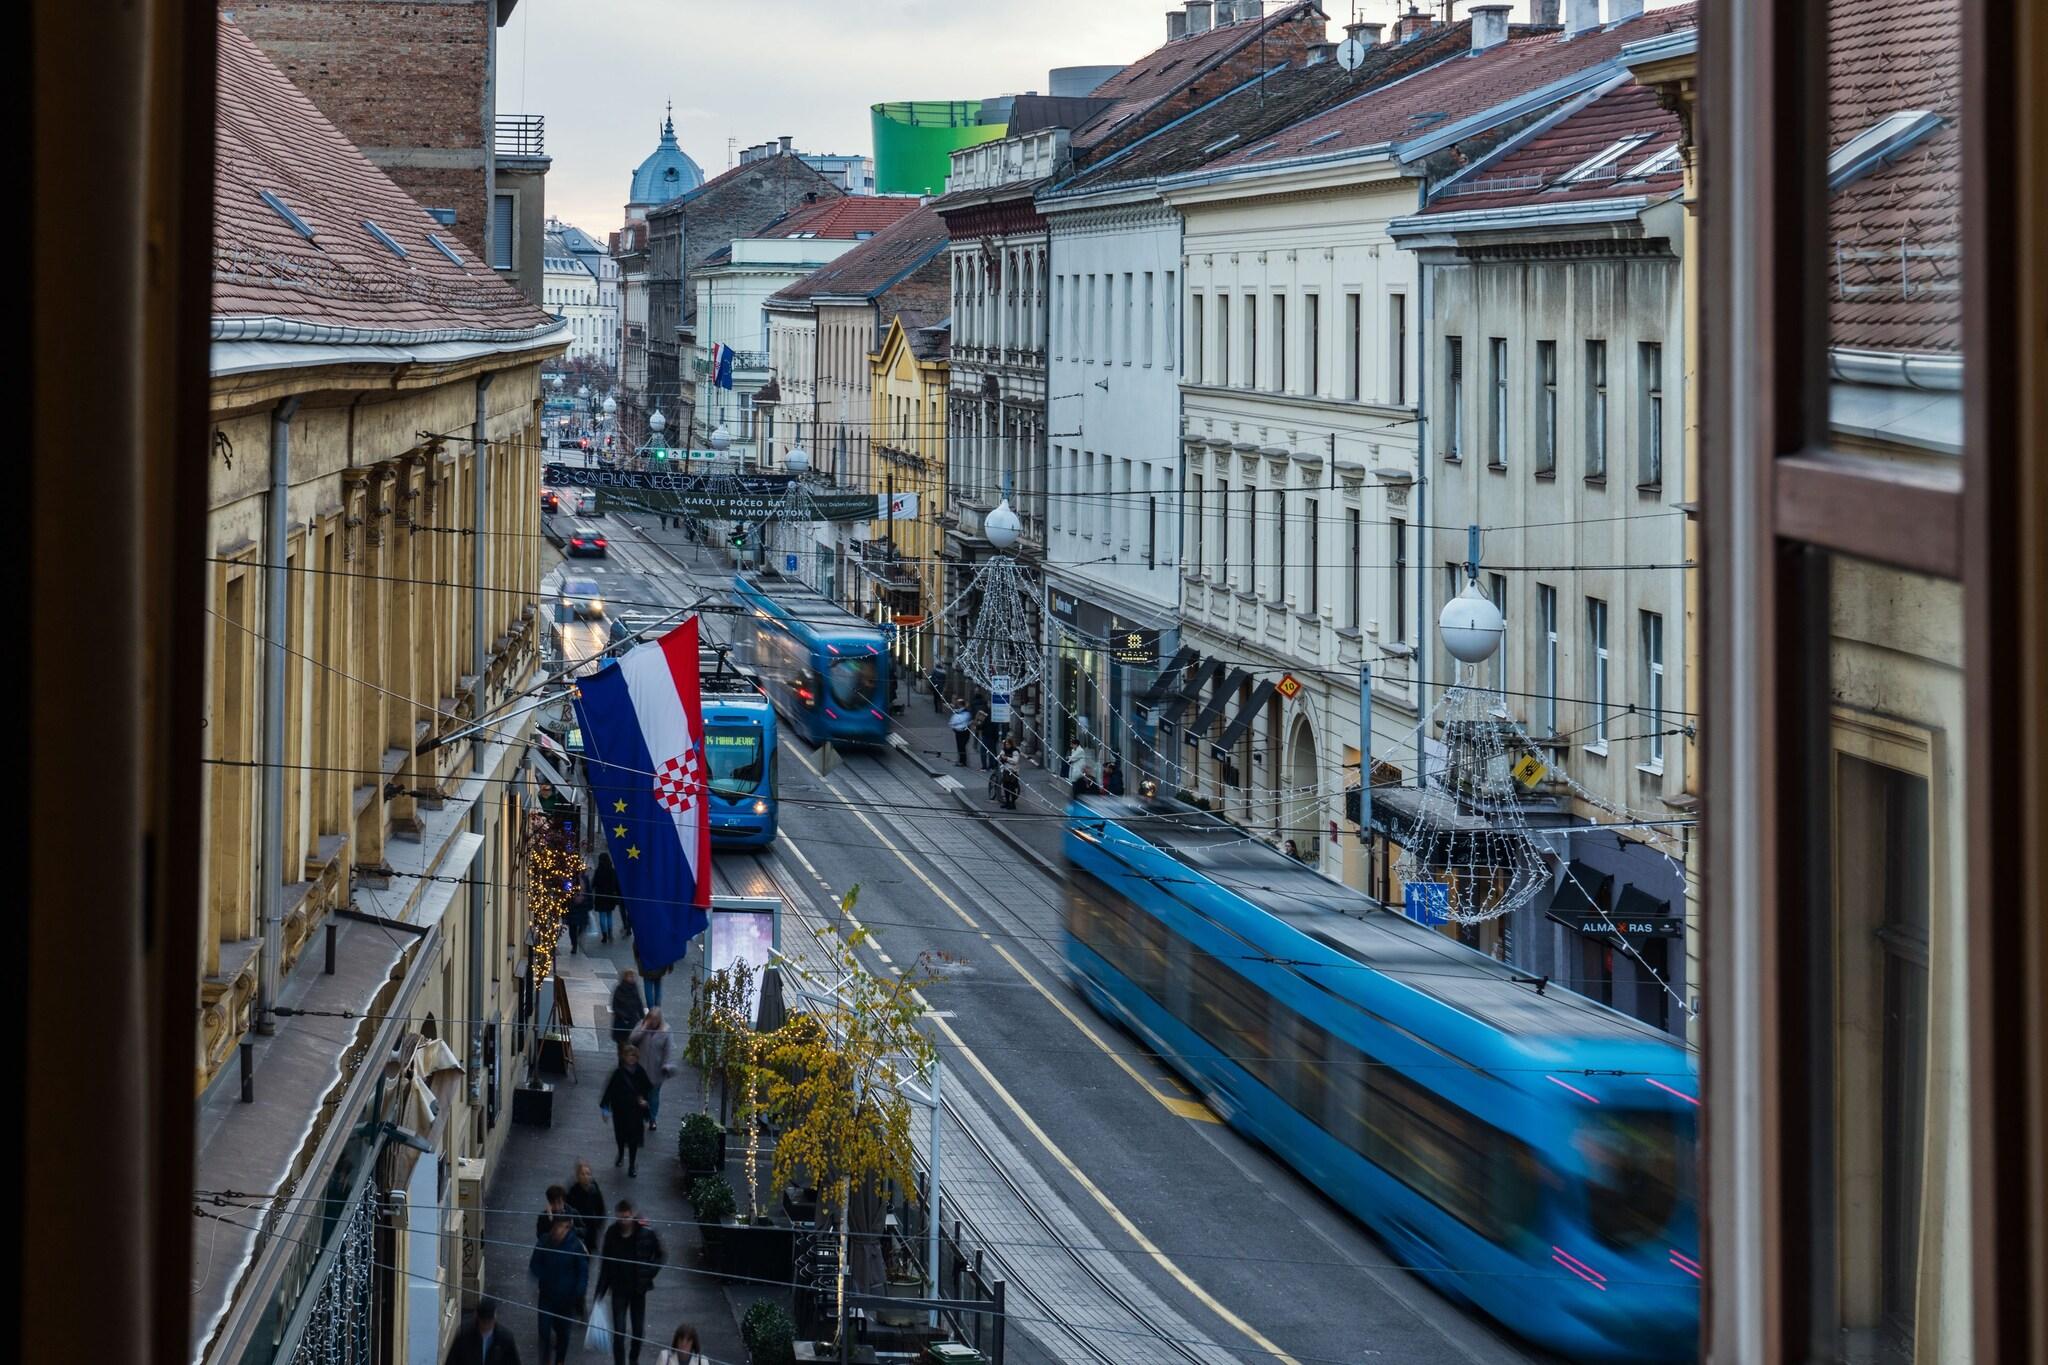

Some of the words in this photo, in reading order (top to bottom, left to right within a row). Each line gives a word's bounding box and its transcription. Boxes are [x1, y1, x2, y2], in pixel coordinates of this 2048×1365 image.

[684, 497, 712, 505] KAKO
[716, 498, 726, 506] JE
[730, 497, 763, 507] POČEO
[748, 509, 774, 517] MOM
[1284, 682, 1295, 691] 10
[715, 736, 756, 746] MIHALJEVAC
[1582, 923, 1616, 932] ALMA
[1629, 923, 1653, 932] RAS
